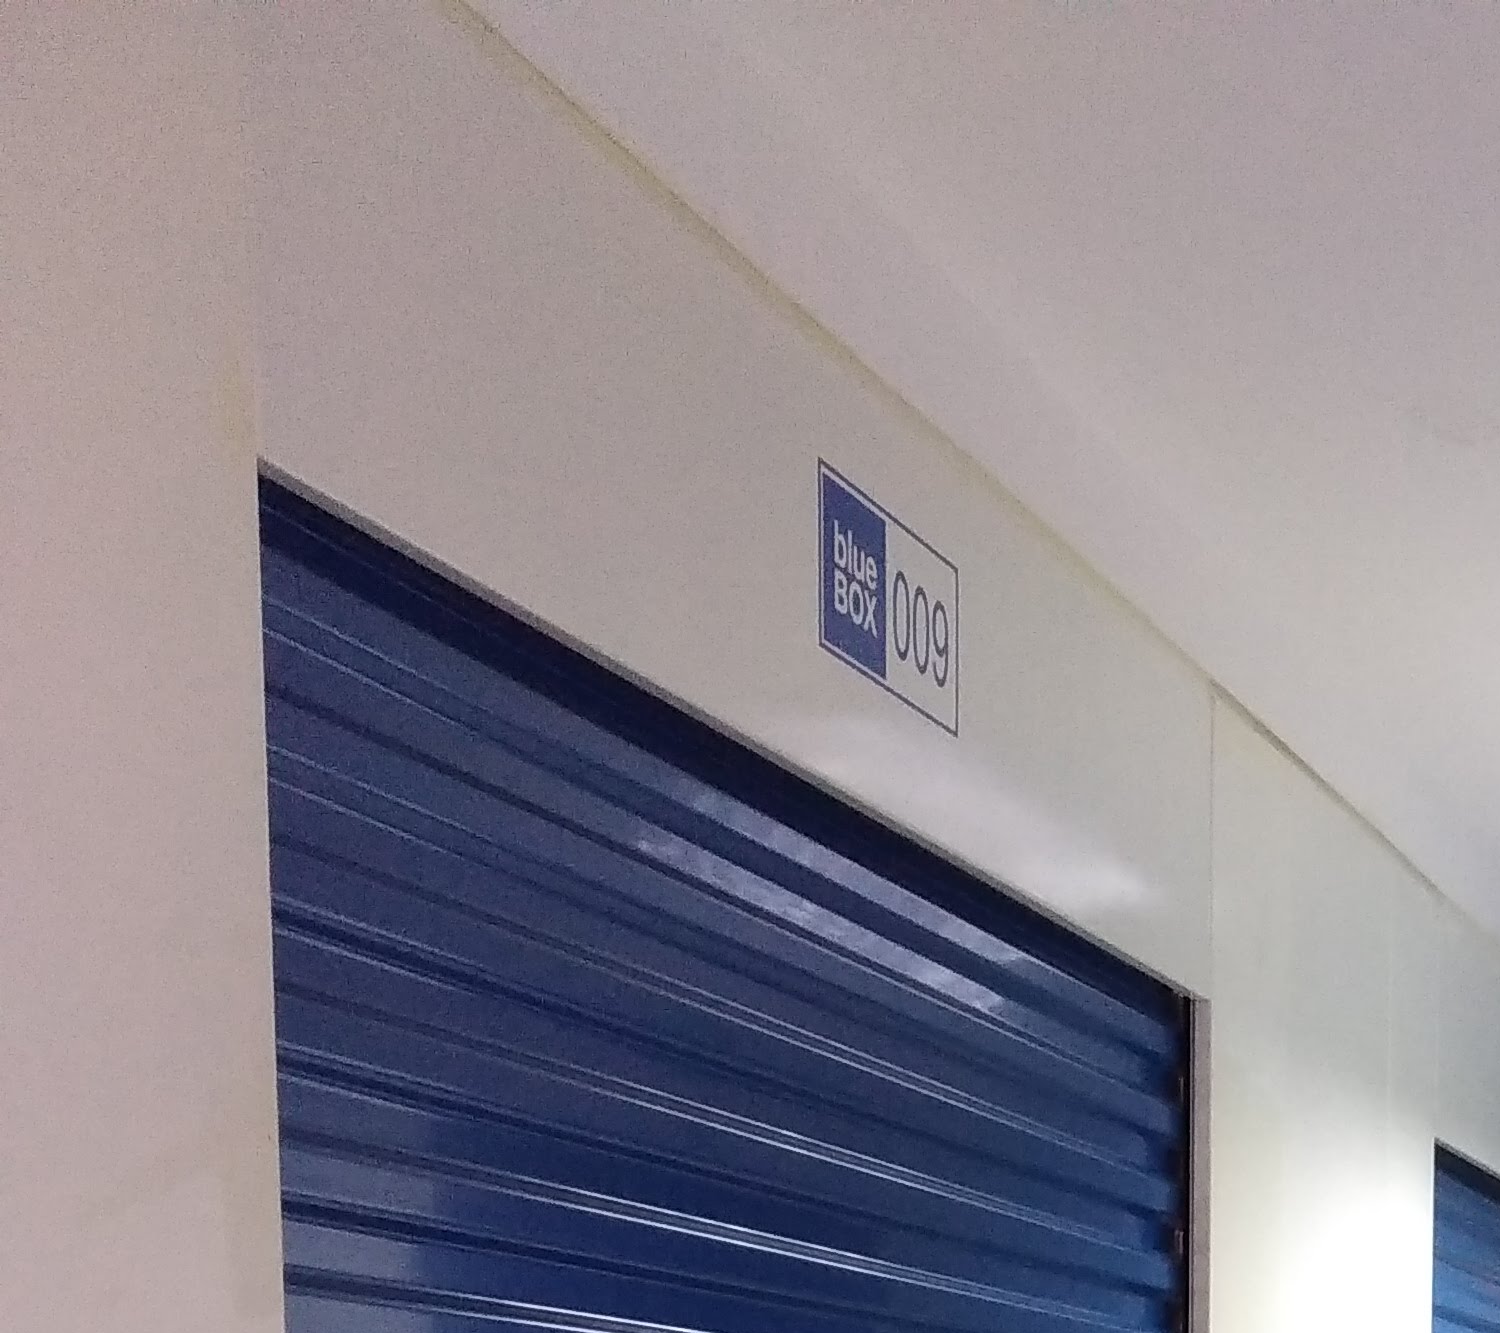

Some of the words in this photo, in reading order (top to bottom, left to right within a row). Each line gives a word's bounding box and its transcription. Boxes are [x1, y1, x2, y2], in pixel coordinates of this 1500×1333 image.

[833, 519, 878, 590] blue
[833, 566, 878, 639] BOX
[892, 570, 949, 688] 009
